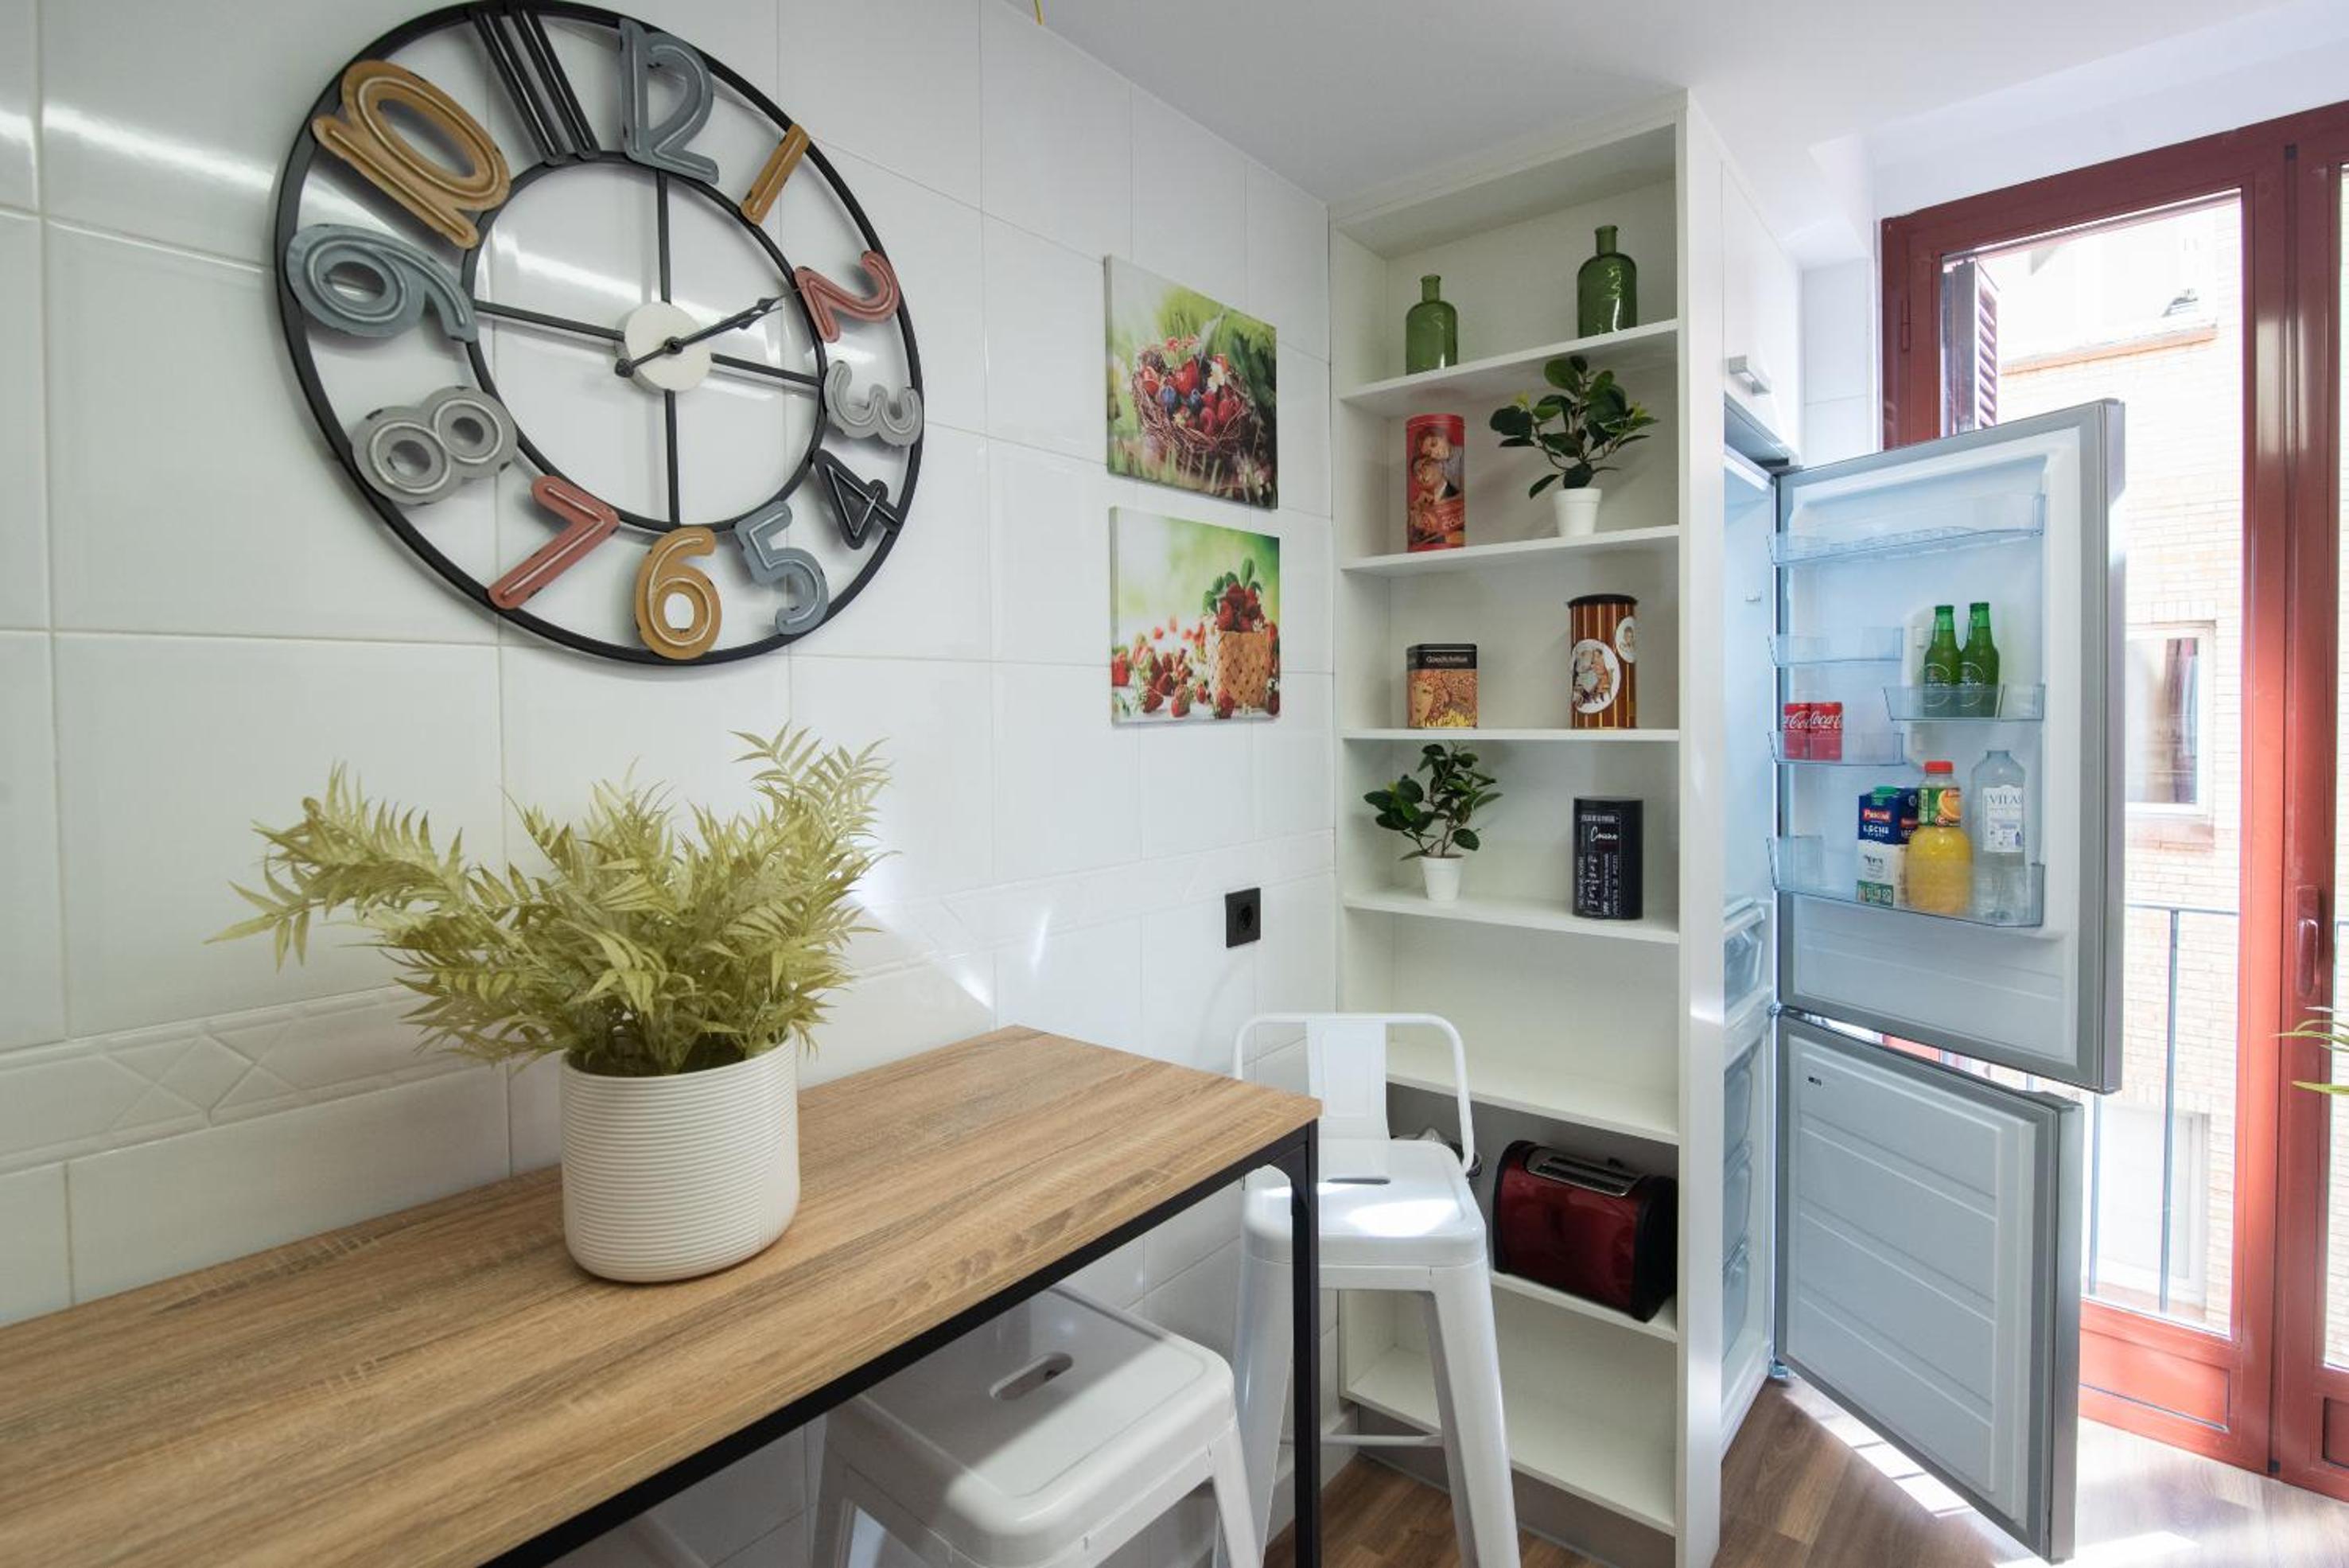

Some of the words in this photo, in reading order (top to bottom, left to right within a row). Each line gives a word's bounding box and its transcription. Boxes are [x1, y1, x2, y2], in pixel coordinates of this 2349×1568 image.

[313, 60, 511, 249] 10
[619, 18, 719, 184] 12
[741, 124, 811, 227] 1
[286, 224, 478, 342] 9
[795, 250, 901, 344] 2
[352, 386, 519, 506] 8
[823, 360, 924, 448] 3
[488, 477, 620, 610] 7
[814, 449, 901, 550] 4
[636, 527, 721, 660] 6
[735, 501, 830, 636] 5
